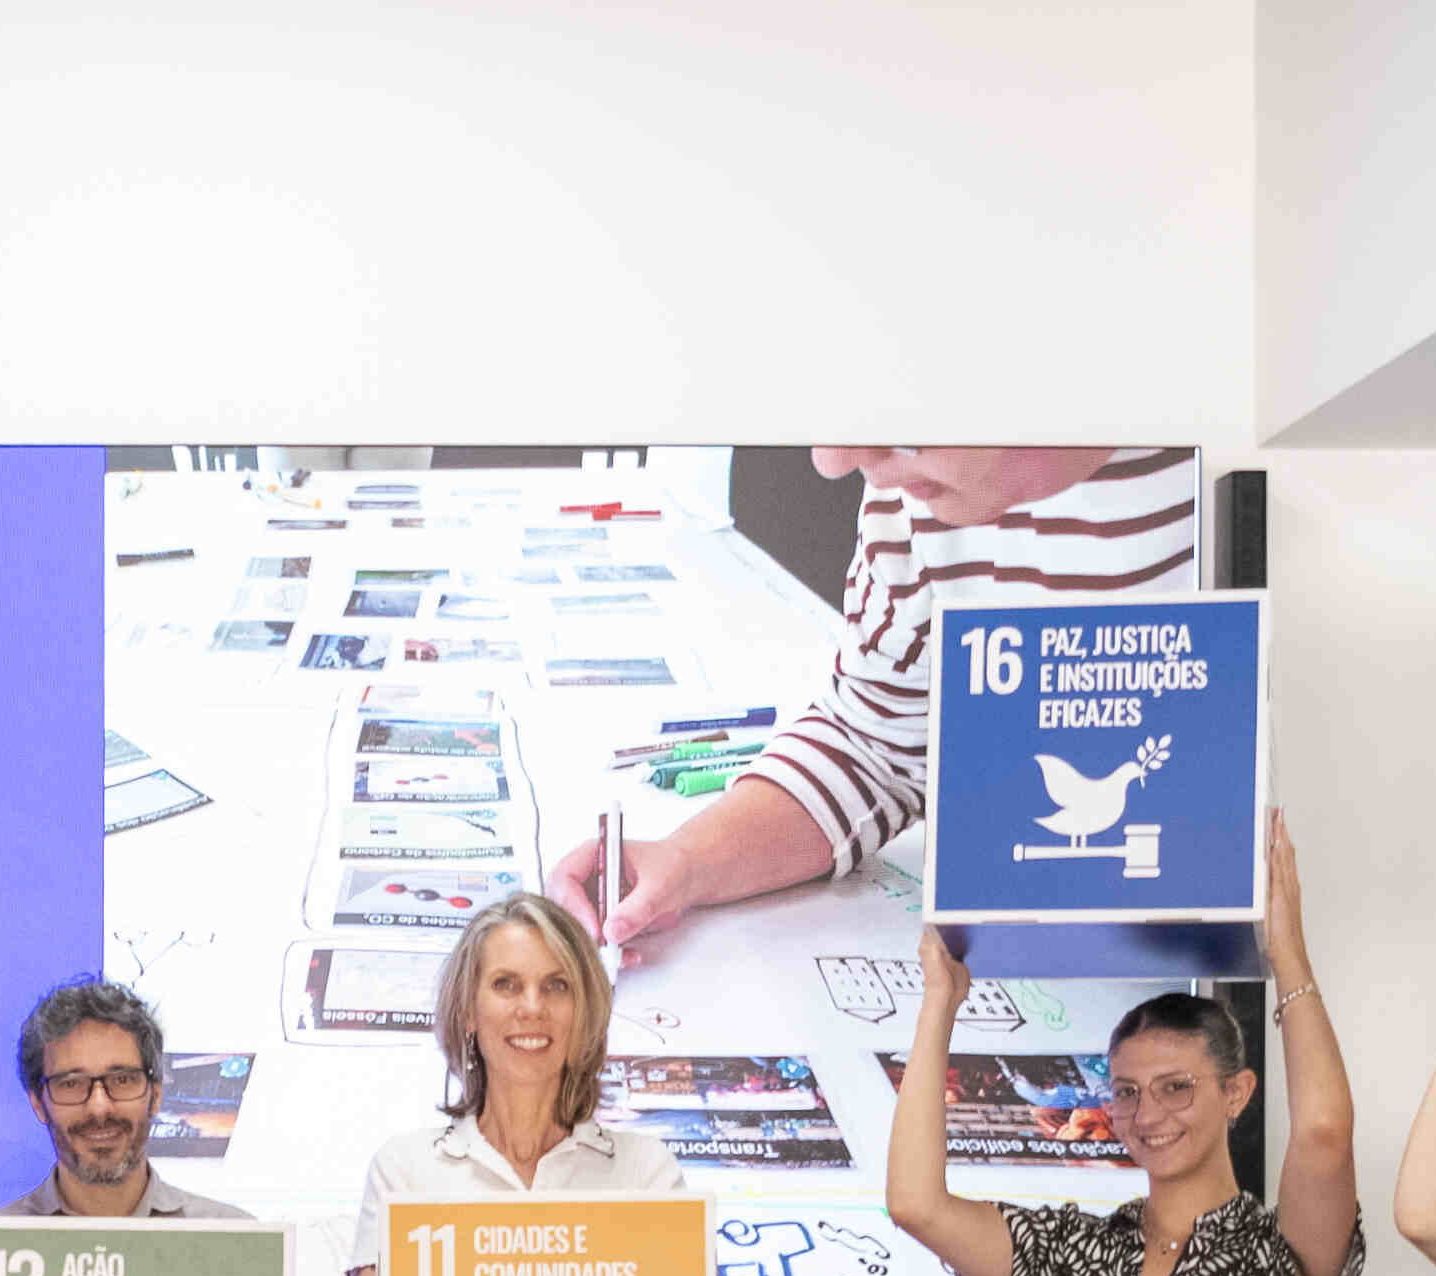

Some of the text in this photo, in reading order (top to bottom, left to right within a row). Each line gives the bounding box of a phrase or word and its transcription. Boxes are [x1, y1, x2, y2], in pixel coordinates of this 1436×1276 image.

[960, 626, 1023, 696] 16
[1040, 624, 1192, 661] PAZ, JUSTIÇA
[1040, 655, 1209, 698] E INSTITUIÇÕES
[1038, 697, 1143, 729] EFICAZES
[473, 1224, 588, 1255] CIDADES E
